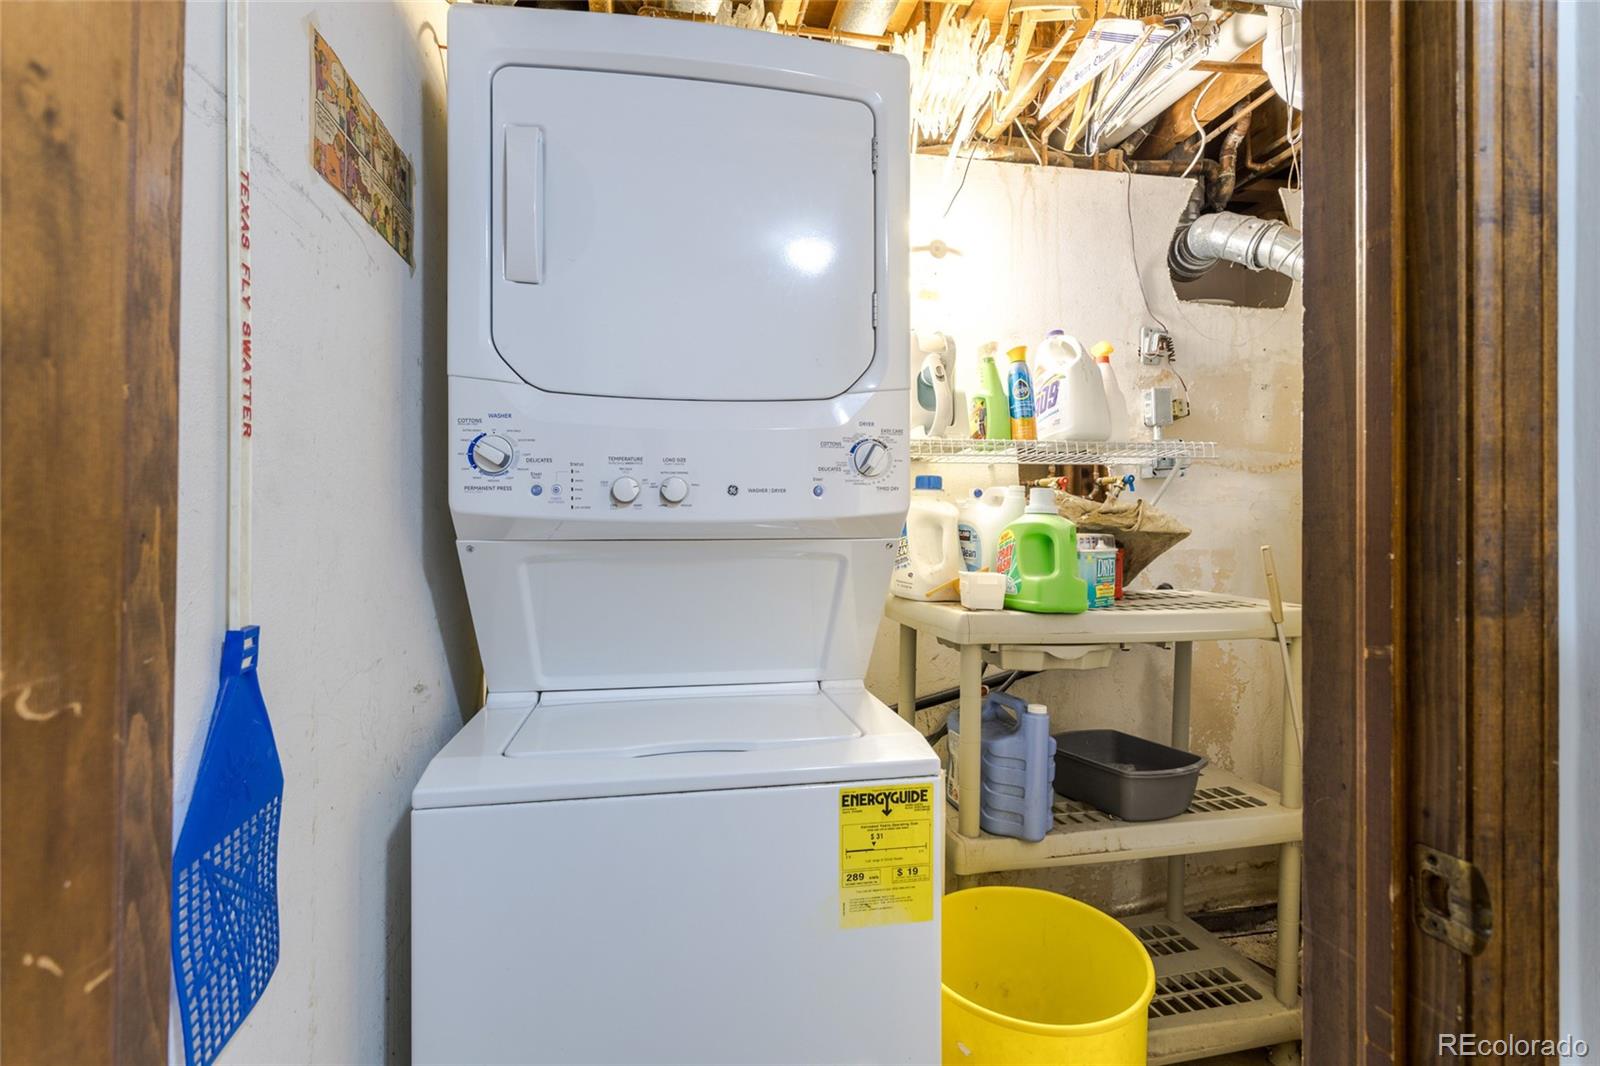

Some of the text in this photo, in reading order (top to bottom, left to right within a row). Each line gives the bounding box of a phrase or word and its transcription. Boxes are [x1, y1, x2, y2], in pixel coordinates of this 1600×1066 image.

[240, 170, 253, 437] TEXAS FLY SWATTER
[841, 789, 929, 808] ENERGYGUIDE
[846, 872, 865, 882] 289
[897, 868, 903, 877] $
[907, 867, 919, 876] 19
